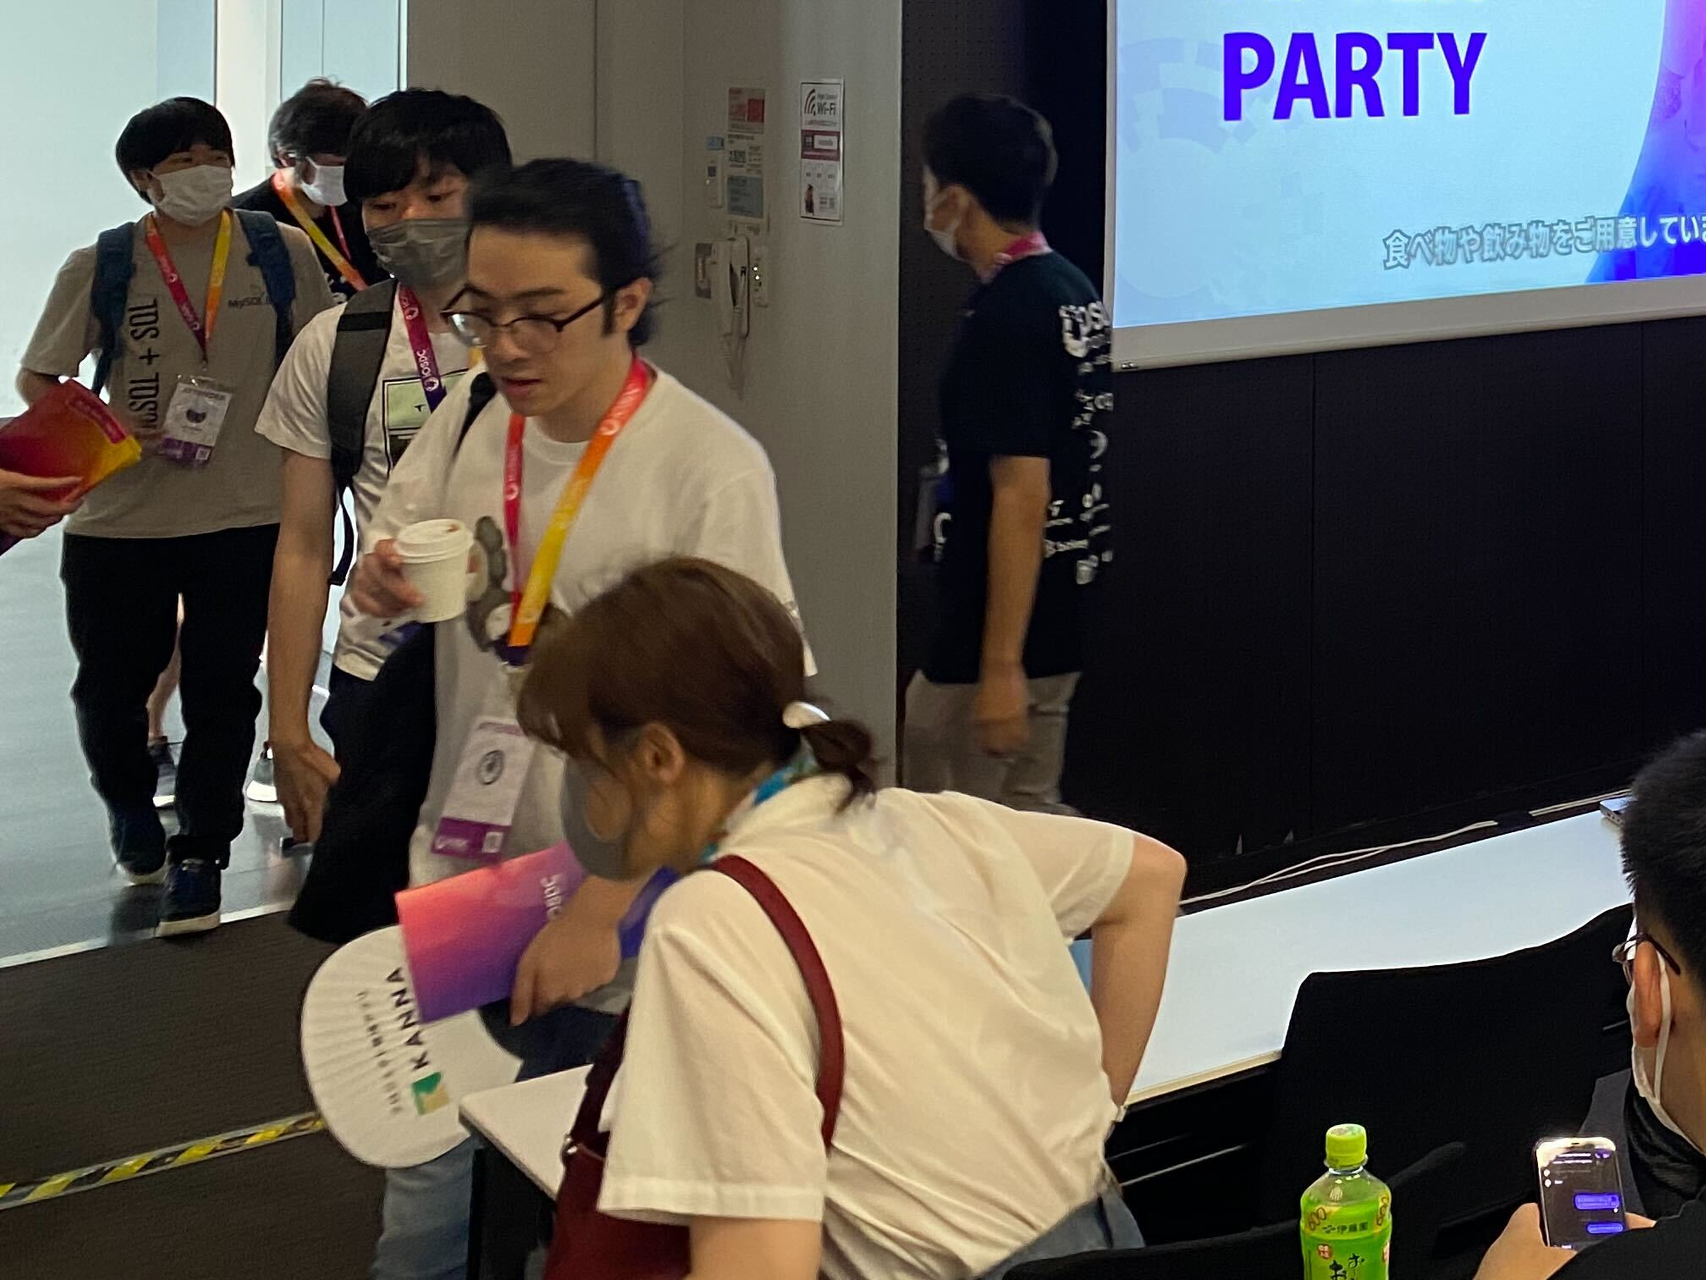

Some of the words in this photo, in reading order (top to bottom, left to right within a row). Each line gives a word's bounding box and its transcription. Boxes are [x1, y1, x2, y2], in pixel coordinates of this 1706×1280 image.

[1223, 31, 1489, 122] PARTY
[128, 298, 159, 341] SQL
[386, 967, 430, 1070] KANNA
